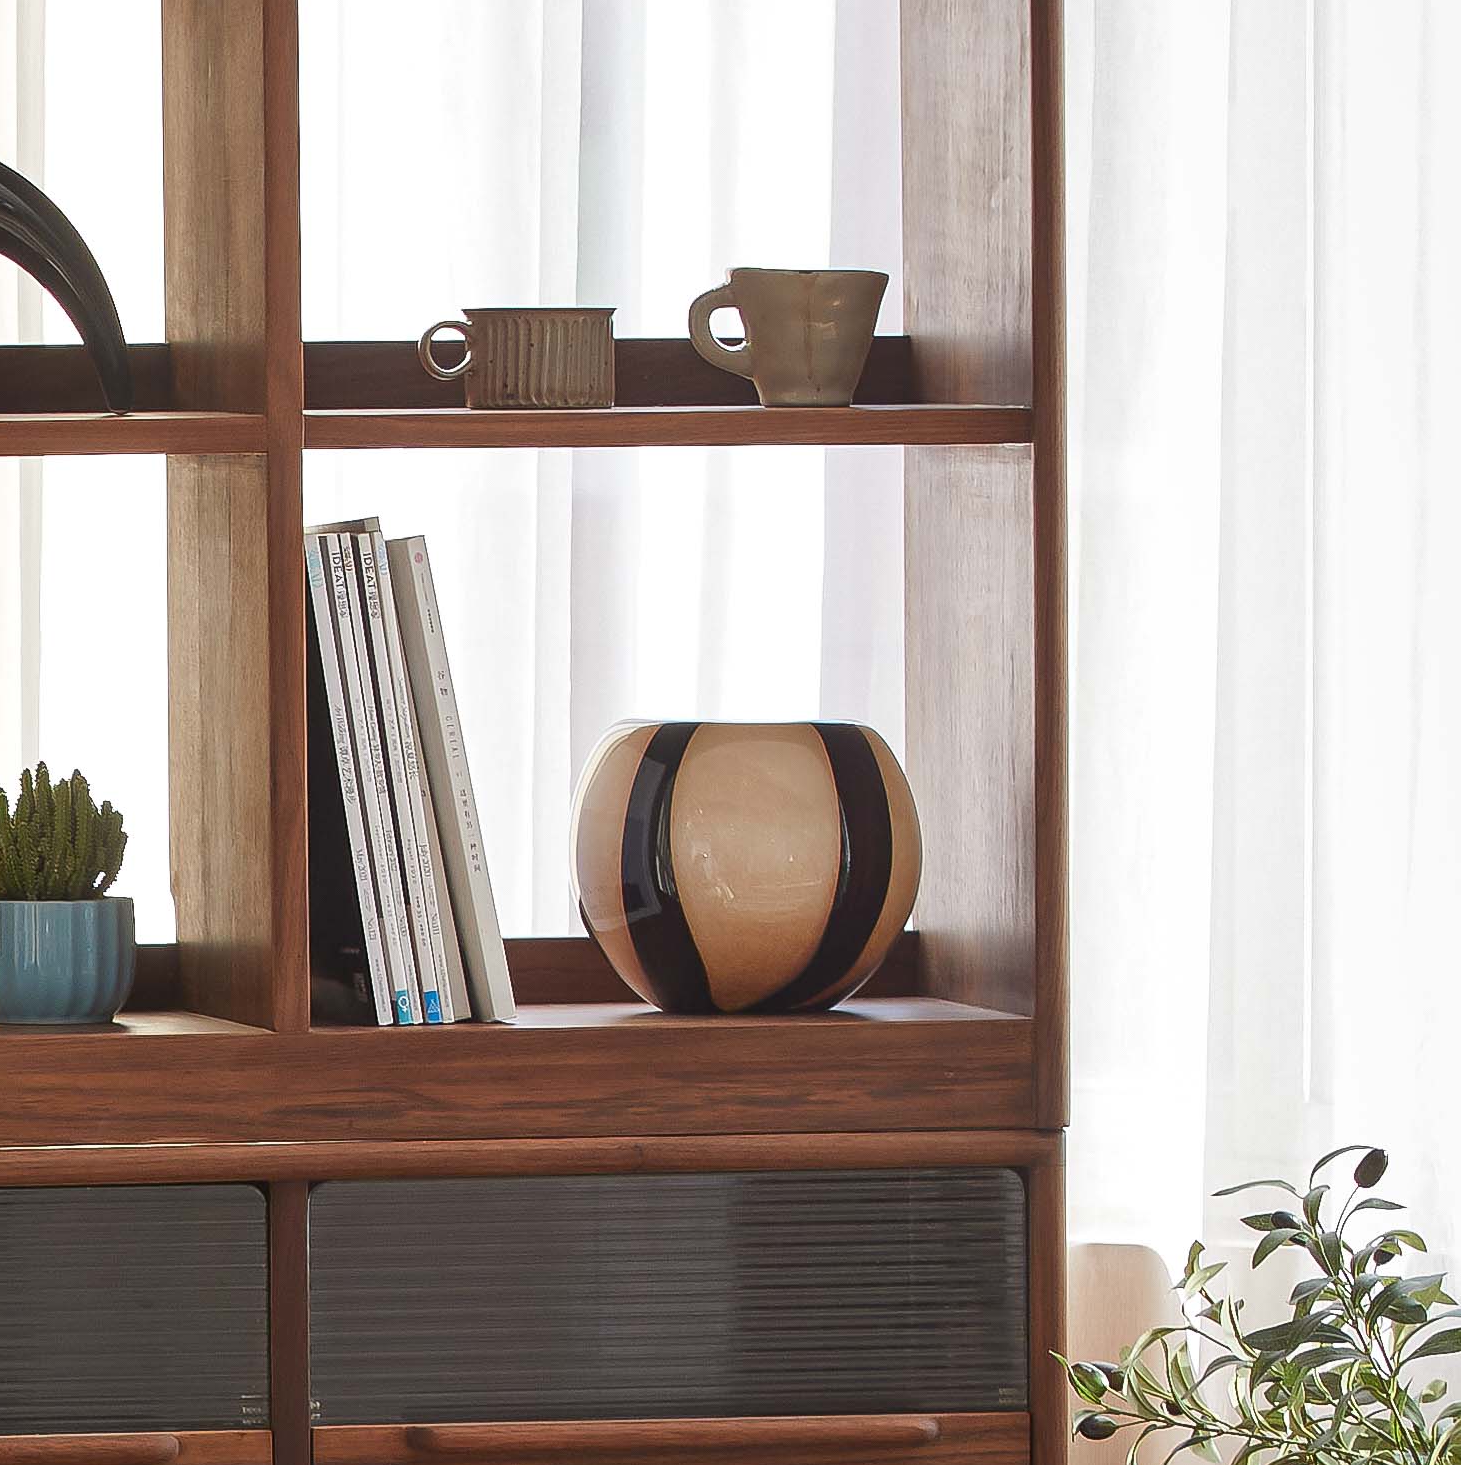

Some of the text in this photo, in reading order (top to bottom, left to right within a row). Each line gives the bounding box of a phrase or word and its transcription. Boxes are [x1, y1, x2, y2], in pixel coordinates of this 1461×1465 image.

[331, 551, 344, 589] IDEAT
[362, 552, 375, 589] IDEAT
[445, 715, 460, 760] CEREAL
